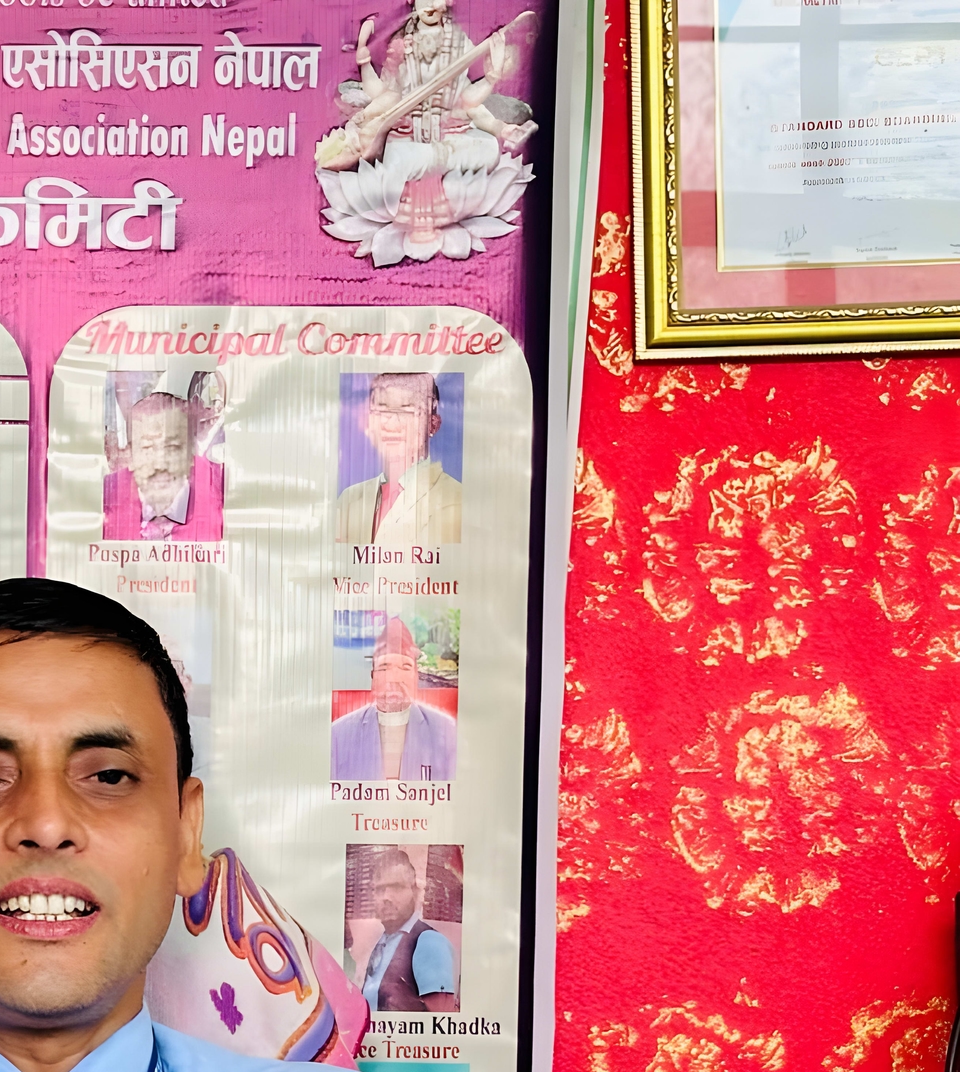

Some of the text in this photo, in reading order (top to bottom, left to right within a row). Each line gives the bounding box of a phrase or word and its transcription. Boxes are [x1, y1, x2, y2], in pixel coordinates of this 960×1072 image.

[1, 30, 202, 91] एसोसिएसन
[214, 32, 322, 90] नेपाल
[7, 114, 187, 155] Association
[202, 113, 295, 167] Nepal
[86, 320, 505, 366] Municipal Committee
[353, 546, 440, 565] Milan Rai
[334, 576, 459, 595] Vice President
[331, 783, 451, 805] Padam Sanjel
[352, 814, 428, 831] Treasure
[433, 1017, 500, 1035] Khadka
[382, 1040, 459, 1059] Treasure
